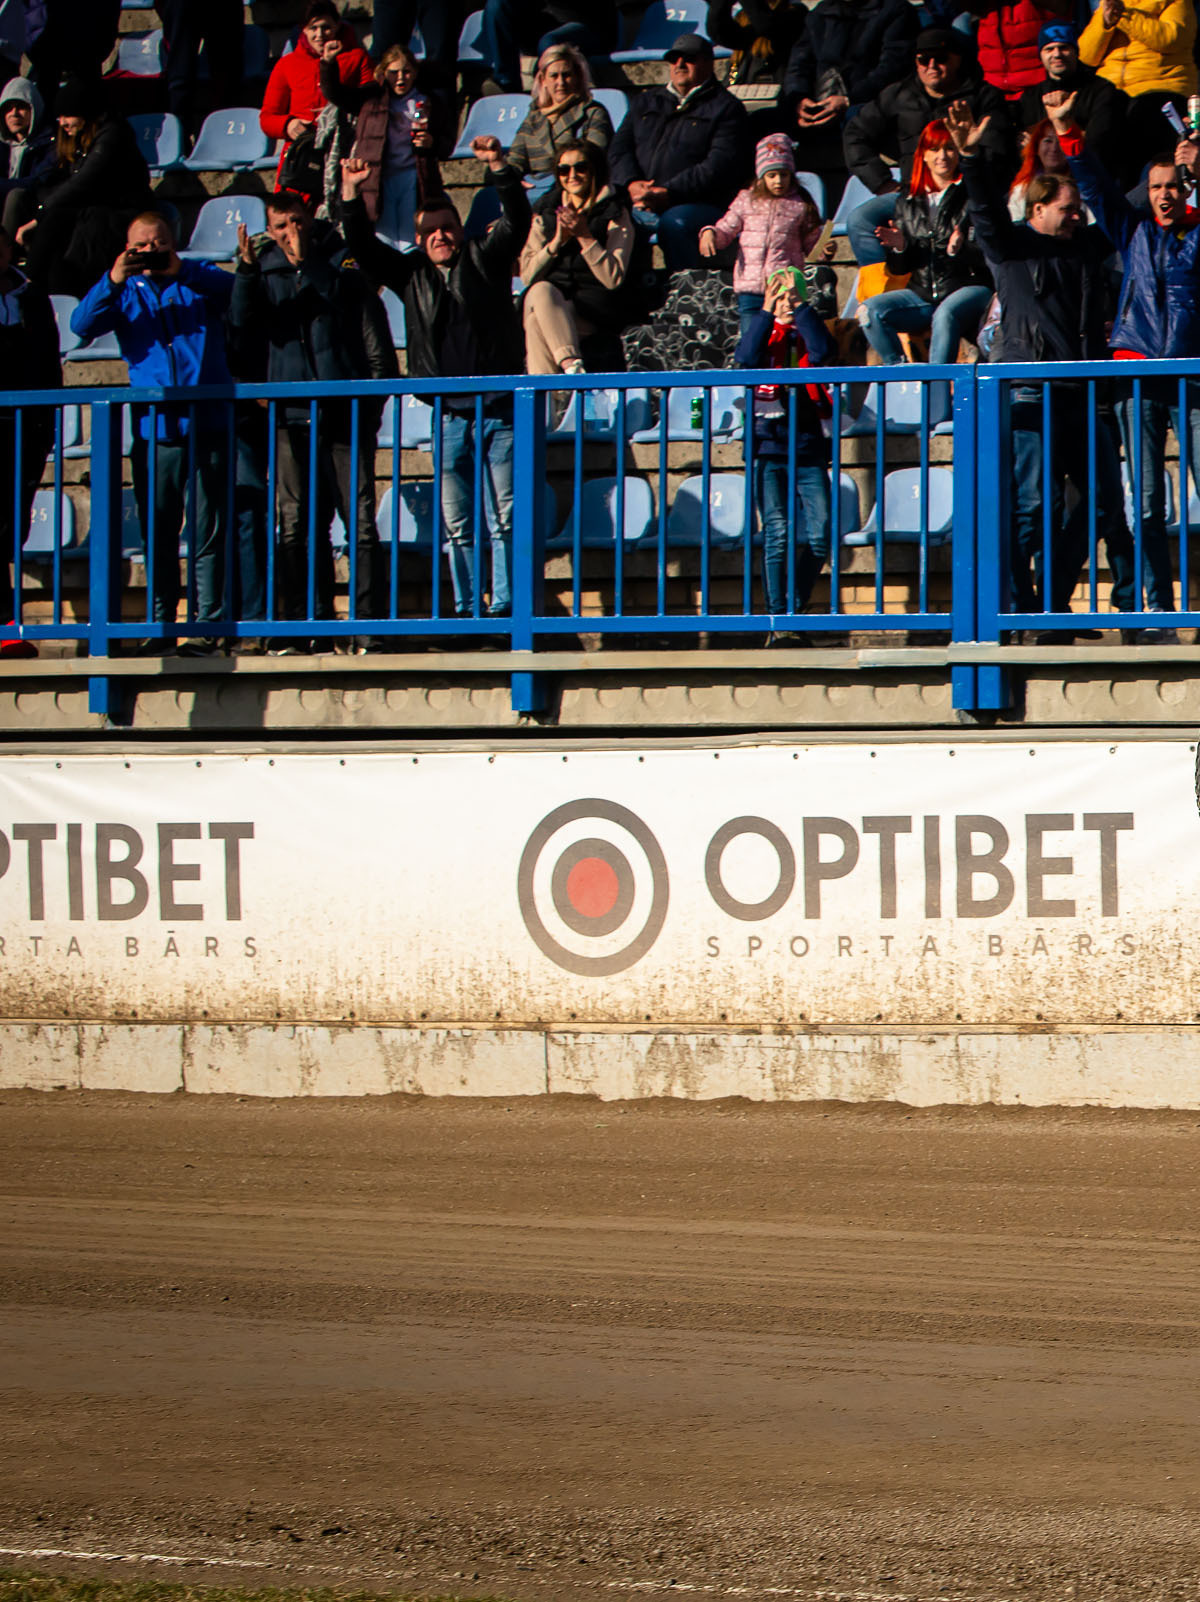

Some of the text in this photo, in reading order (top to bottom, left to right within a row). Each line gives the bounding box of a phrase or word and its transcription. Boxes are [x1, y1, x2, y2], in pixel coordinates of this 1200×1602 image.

[666, 9, 687, 21] 27
[225, 210, 242, 225] 24
[0, 822, 255, 922] TIBET
[705, 812, 1135, 922] OPTIBET
[125, 930, 257, 958] BĀRS
[706, 927, 1137, 958] SPORTA BĀRS
